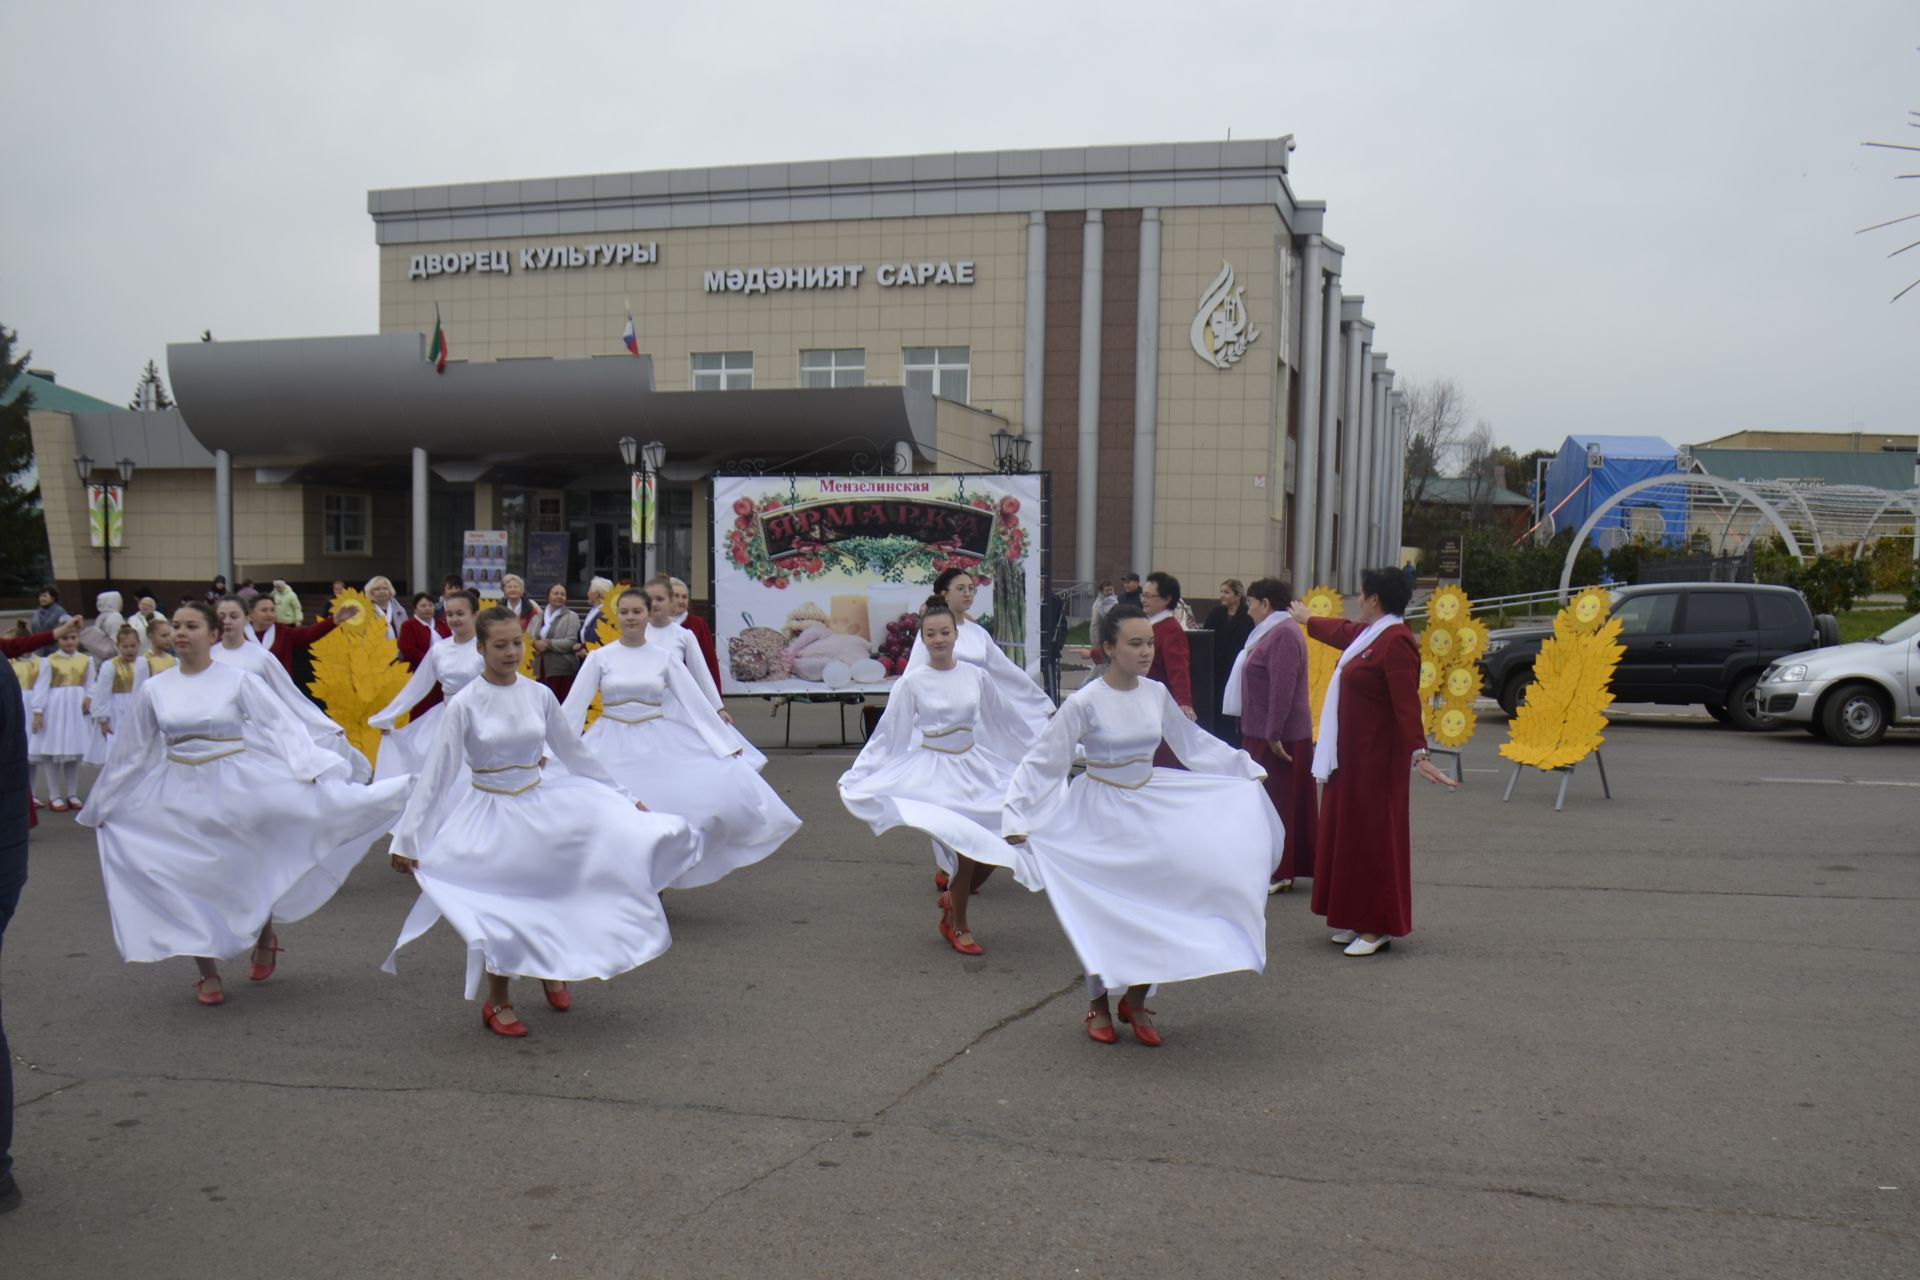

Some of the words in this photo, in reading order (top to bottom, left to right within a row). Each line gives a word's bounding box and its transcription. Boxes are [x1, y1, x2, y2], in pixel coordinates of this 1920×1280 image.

[408, 250, 509, 279] ДВОРЕЦ
[519, 241, 658, 269] КУЛЬТУРЫ
[703, 264, 864, 294] МӘДӘНИЯТ
[876, 261, 975, 287] САРАЕ
[820, 479, 930, 493] Мензелинская
[768, 503, 980, 540] ЯРМАРКА
